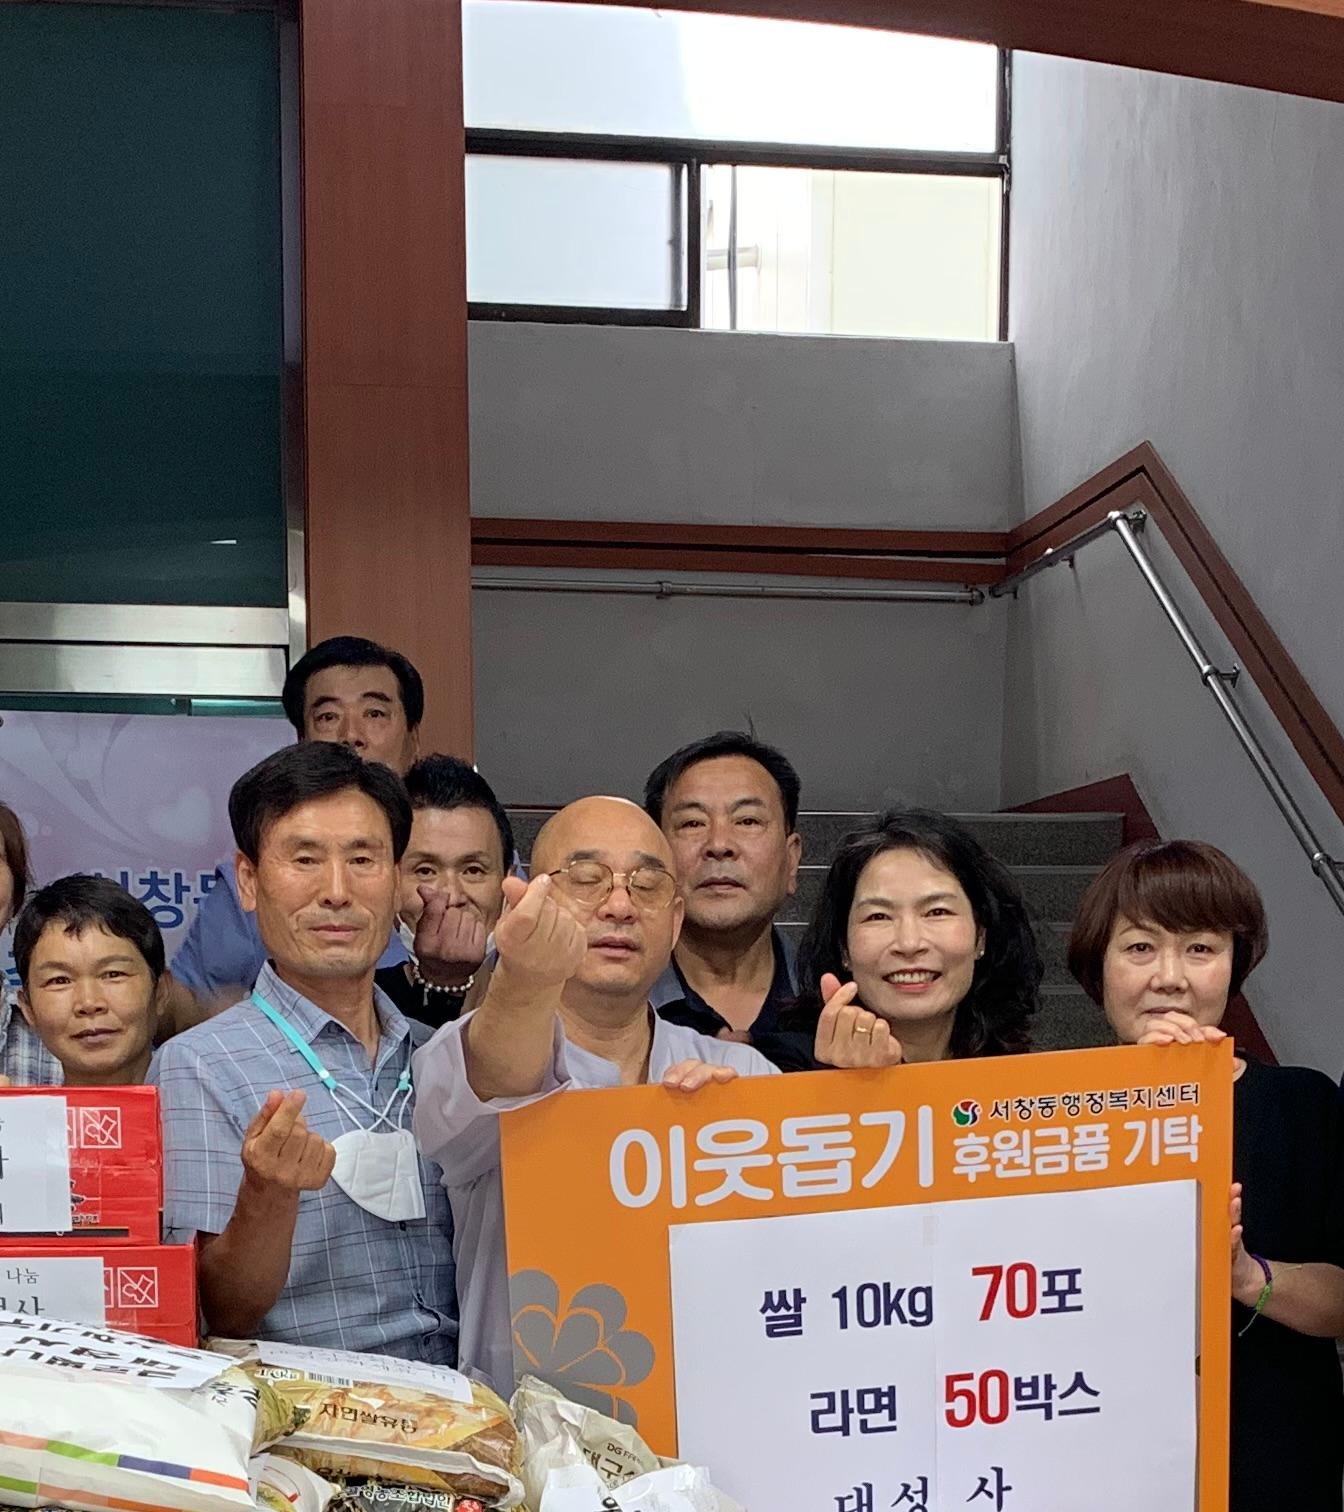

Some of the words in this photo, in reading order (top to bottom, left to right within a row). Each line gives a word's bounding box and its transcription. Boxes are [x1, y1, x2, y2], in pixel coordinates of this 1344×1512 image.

[990, 1083, 1202, 1121] 서창동행정복지센터
[609, 1106, 934, 1209] 이웃돕기
[952, 1122, 1111, 1182] 후원금품
[1123, 1120, 1203, 1166] 기탁
[5, 1265, 40, 1287] 나눔
[759, 1287, 806, 1339] 쌀
[832, 1282, 934, 1330] 10kg
[971, 1262, 1084, 1322] 70포
[809, 1386, 898, 1437] 라면
[944, 1368, 1102, 1430] 50박스
